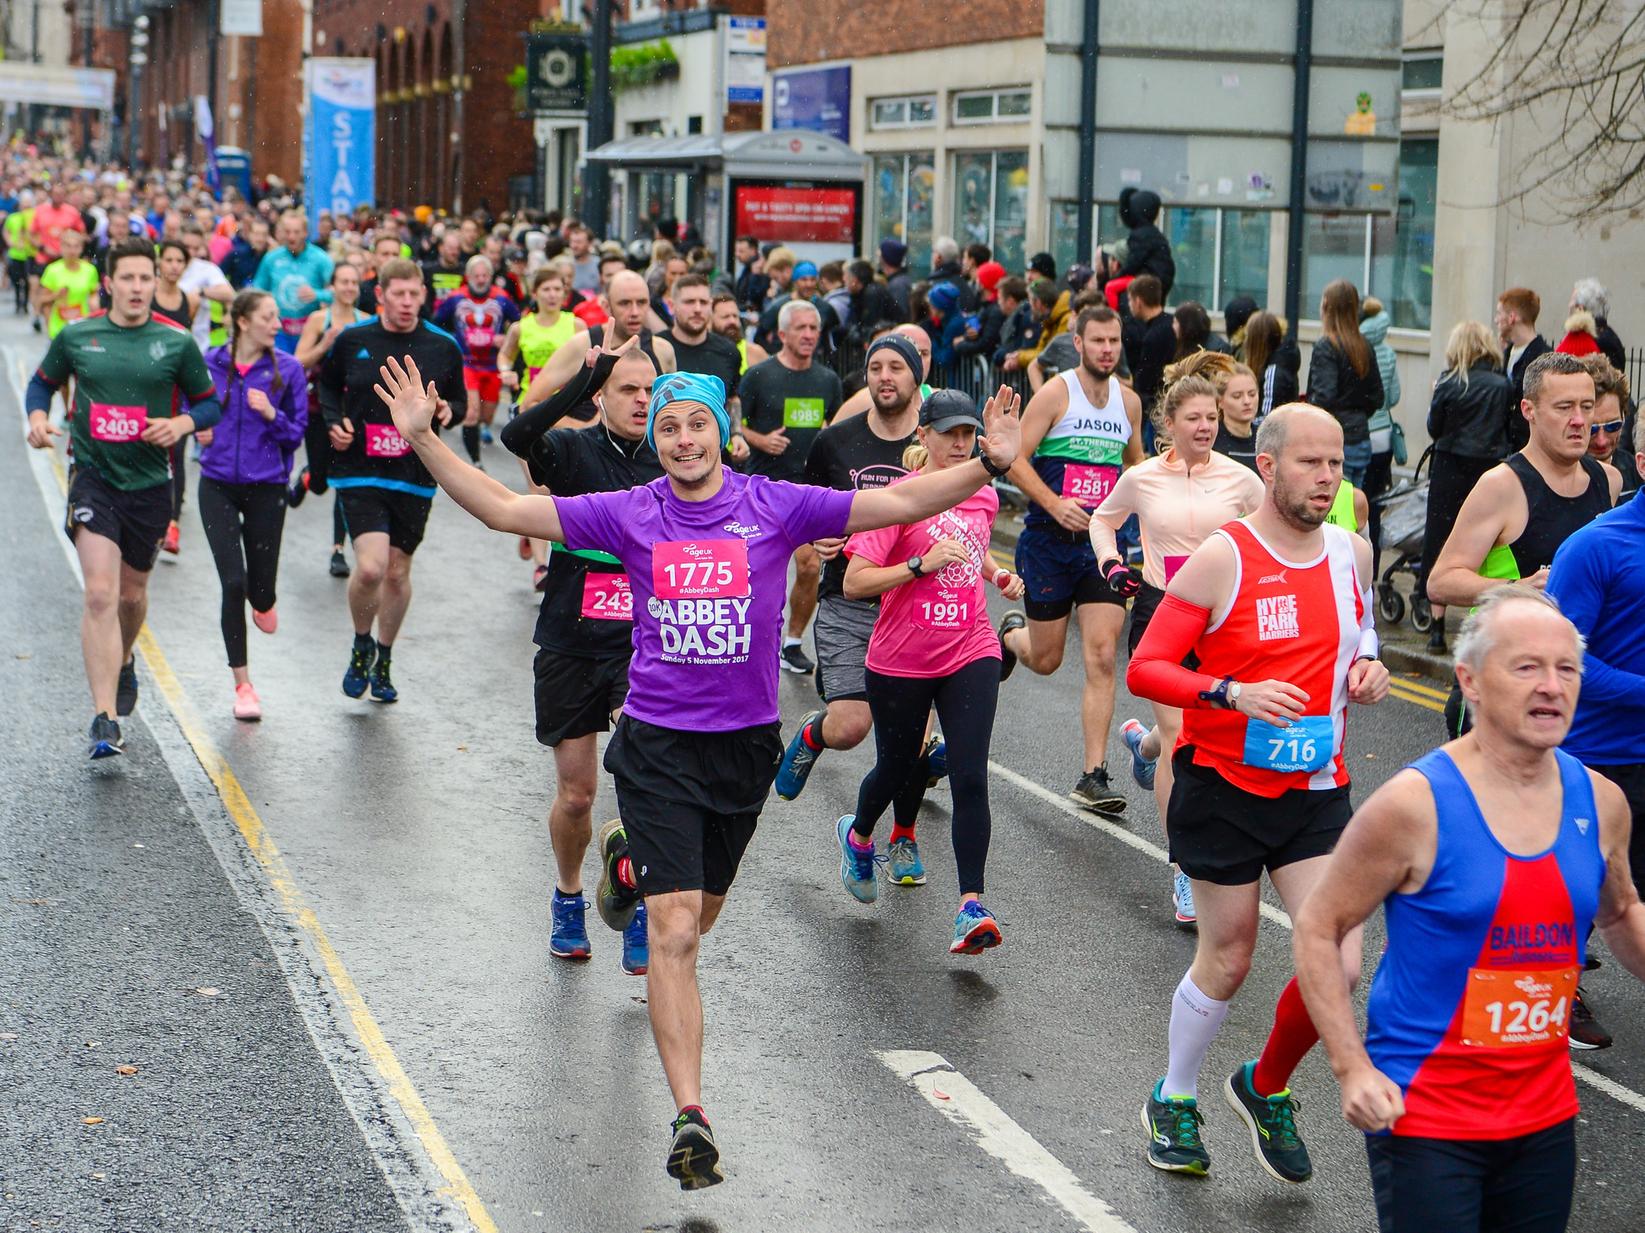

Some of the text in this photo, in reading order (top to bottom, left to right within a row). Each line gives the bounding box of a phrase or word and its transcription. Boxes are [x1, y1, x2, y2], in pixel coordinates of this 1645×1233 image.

[790, 408, 820, 422] 4985
[96, 416, 139, 436] 2403
[1073, 418, 1122, 435] JASON
[1071, 478, 1110, 495] 2581
[663, 561, 734, 587] 1775
[679, 586, 720, 595] #AbbeyDash
[660, 598, 752, 625] ABBEY
[921, 602, 968, 621] 1991
[1256, 594, 1298, 616] HYDE
[1258, 612, 1299, 632] PARK
[660, 623, 752, 656] DASH
[1259, 629, 1300, 641] HARRIERS
[661, 653, 749, 665] Sunday 5 November 2017
[1268, 738, 1317, 762] 716
[1490, 922, 1573, 950] BAILDON
[1484, 996, 1567, 1034] 1264
